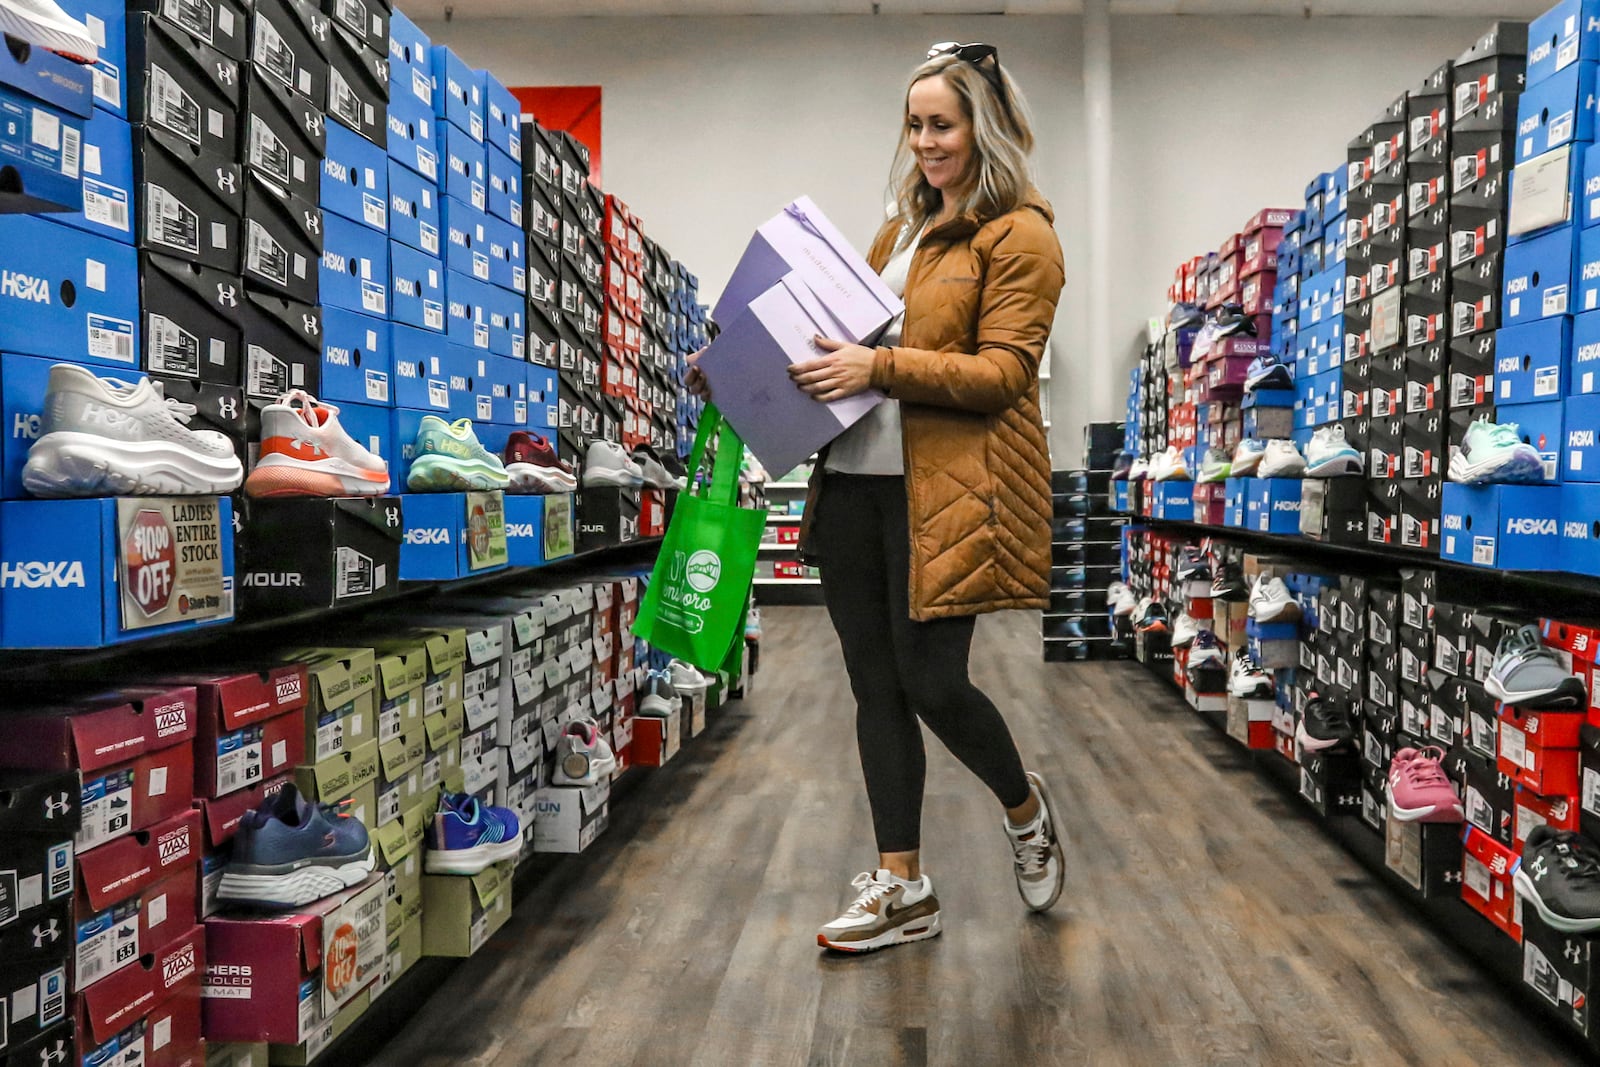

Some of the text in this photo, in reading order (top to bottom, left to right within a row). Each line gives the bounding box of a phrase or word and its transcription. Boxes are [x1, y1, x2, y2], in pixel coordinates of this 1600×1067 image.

[8, 121, 16, 135] 8
[388, 115, 407, 139] HOKA
[324, 157, 347, 184] HOKA
[322, 250, 345, 274] HOKA
[2, 270, 50, 305] HOKA
[396, 276, 414, 297] HOKA
[1507, 276, 1528, 295] HOKA
[326, 346, 349, 367] HOKA
[1498, 357, 1520, 373] HOKA
[166, 362, 186, 371] HOVR
[397, 361, 416, 378] HOKA
[81, 406, 141, 434] HOKA
[1568, 430, 1594, 447] HOKA
[172, 504, 216, 522] LADIES'
[1444, 514, 1461, 530] HOKA
[176, 524, 217, 543] ENTIRE
[1506, 518, 1557, 535] HOKA
[1564, 522, 1587, 539] HOKA
[403, 528, 450, 544] HOKA
[182, 544, 218, 563] STOCK
[1, 561, 85, 589] HOKA
[138, 560, 171, 606] OFF
[279, 680, 300, 698] MAX
[154, 702, 185, 715] SKECHERS
[159, 710, 185, 729] MAX
[250, 766, 255, 777] 5
[115, 817, 122, 829] 9
[158, 825, 189, 843] SKECHERS
[161, 833, 190, 858] MAX
[119, 944, 133, 960] 5.5
[162, 943, 193, 966] SKECHERS
[166, 950, 194, 980] MAX
[213, 988, 242, 996] MAT
